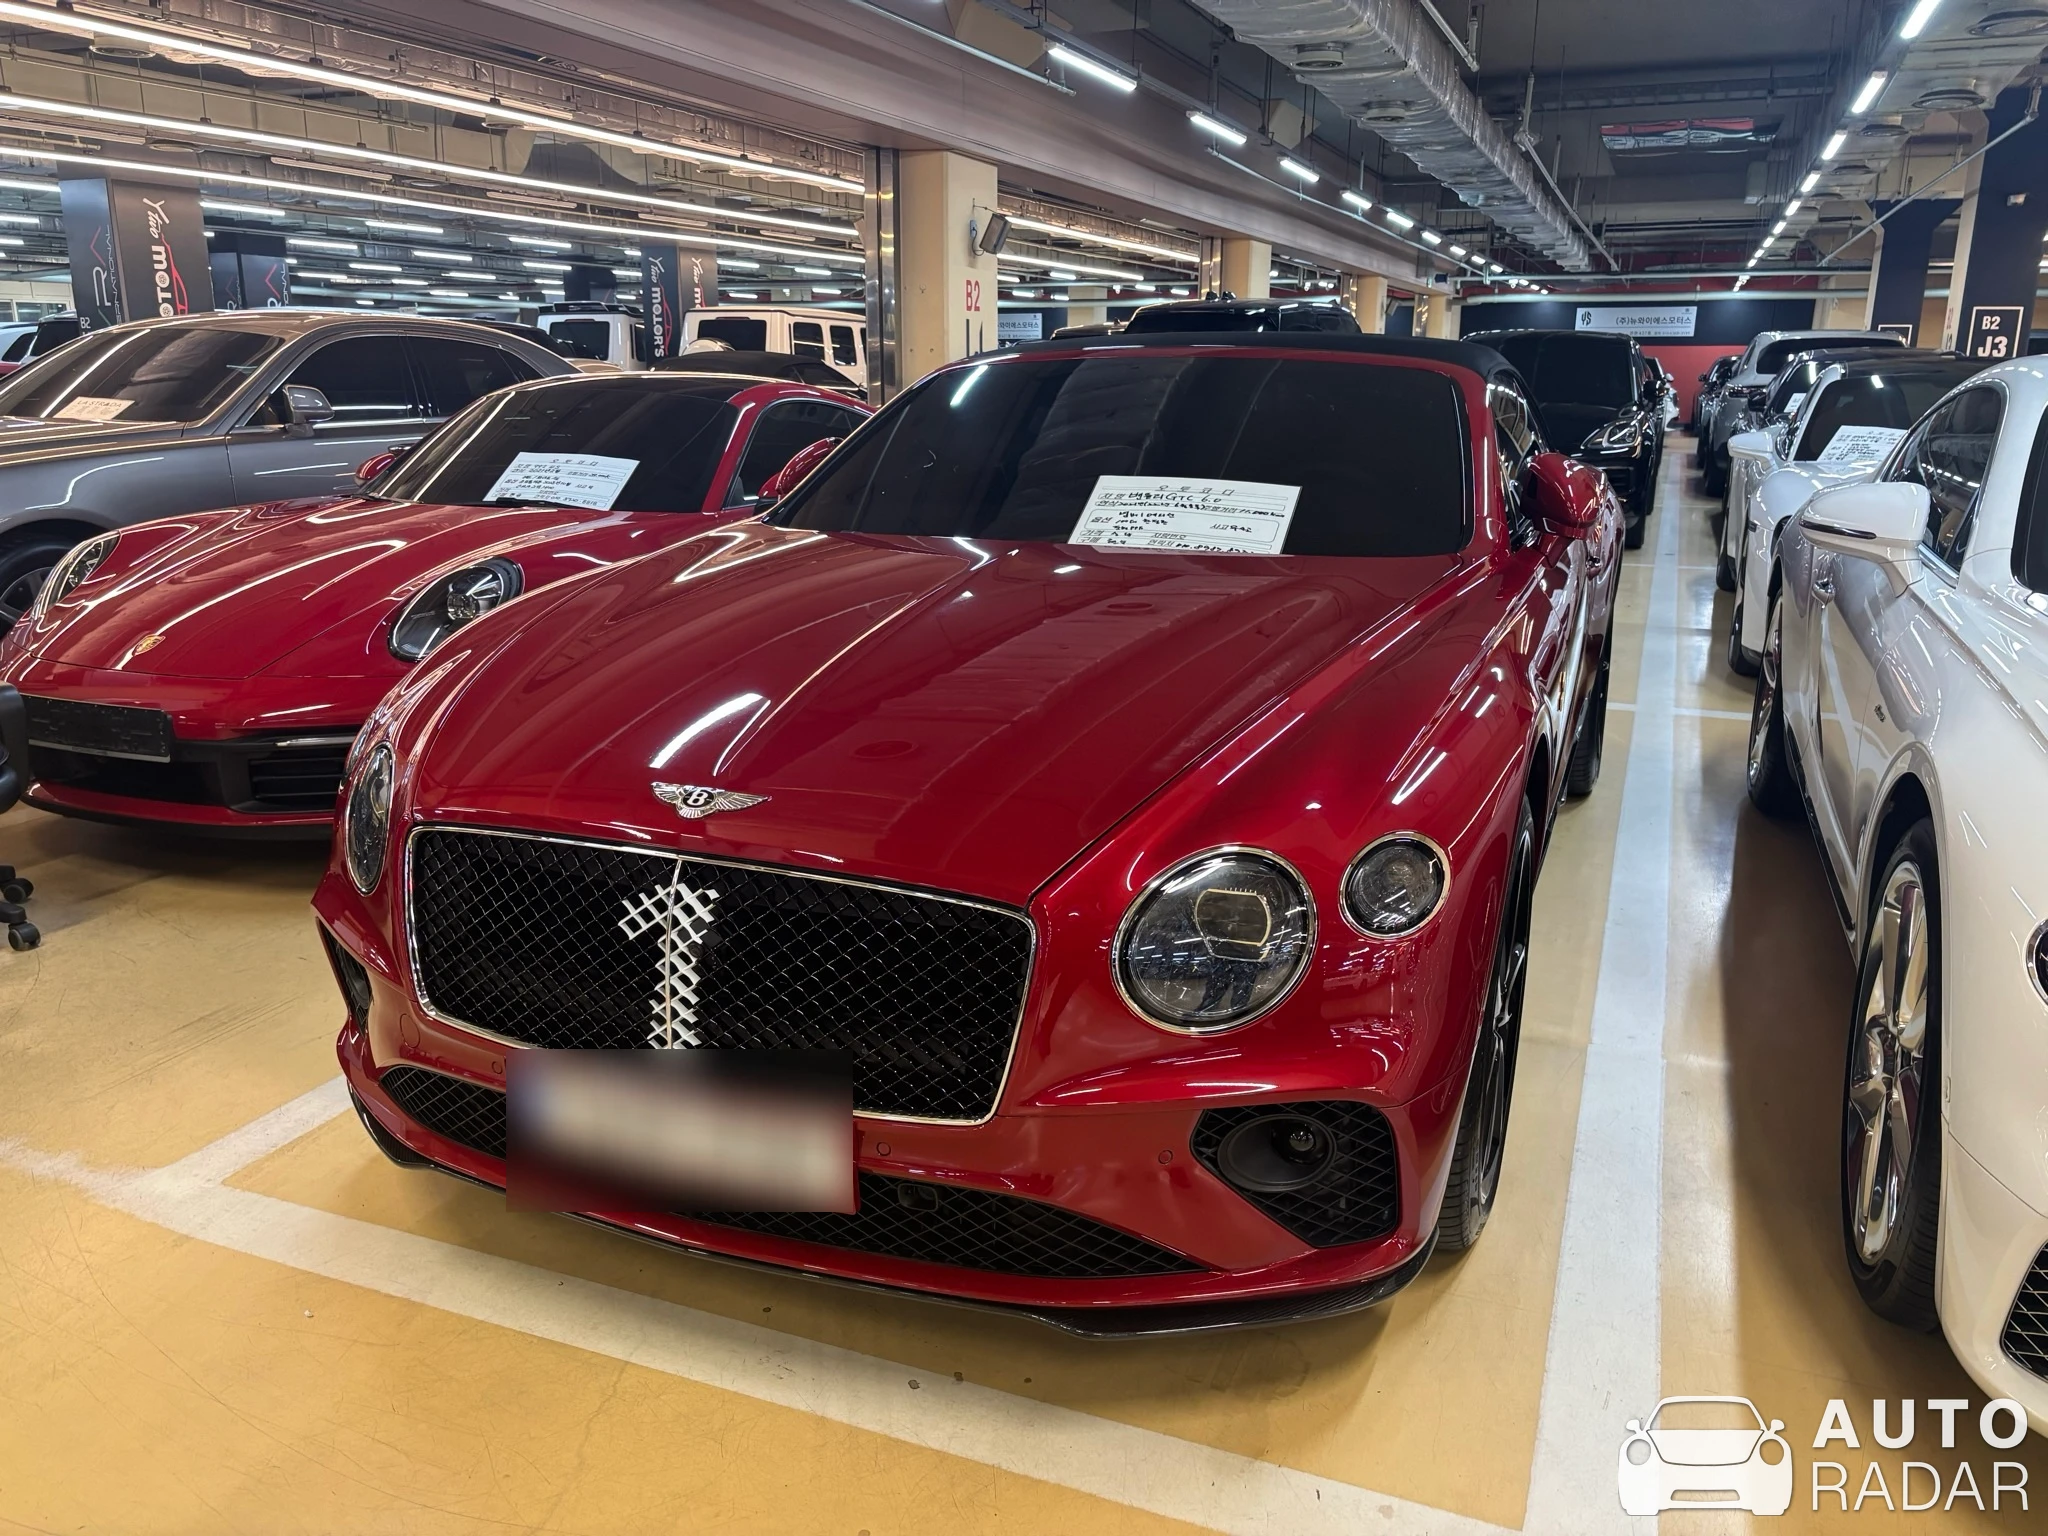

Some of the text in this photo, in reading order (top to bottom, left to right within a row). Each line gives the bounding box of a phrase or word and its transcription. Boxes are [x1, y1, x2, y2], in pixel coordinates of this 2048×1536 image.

[966, 279, 980, 312] B2
[80, 316, 91, 329] B2
[1981, 315, 2001, 330] B2
[1977, 335, 2008, 358] J3
